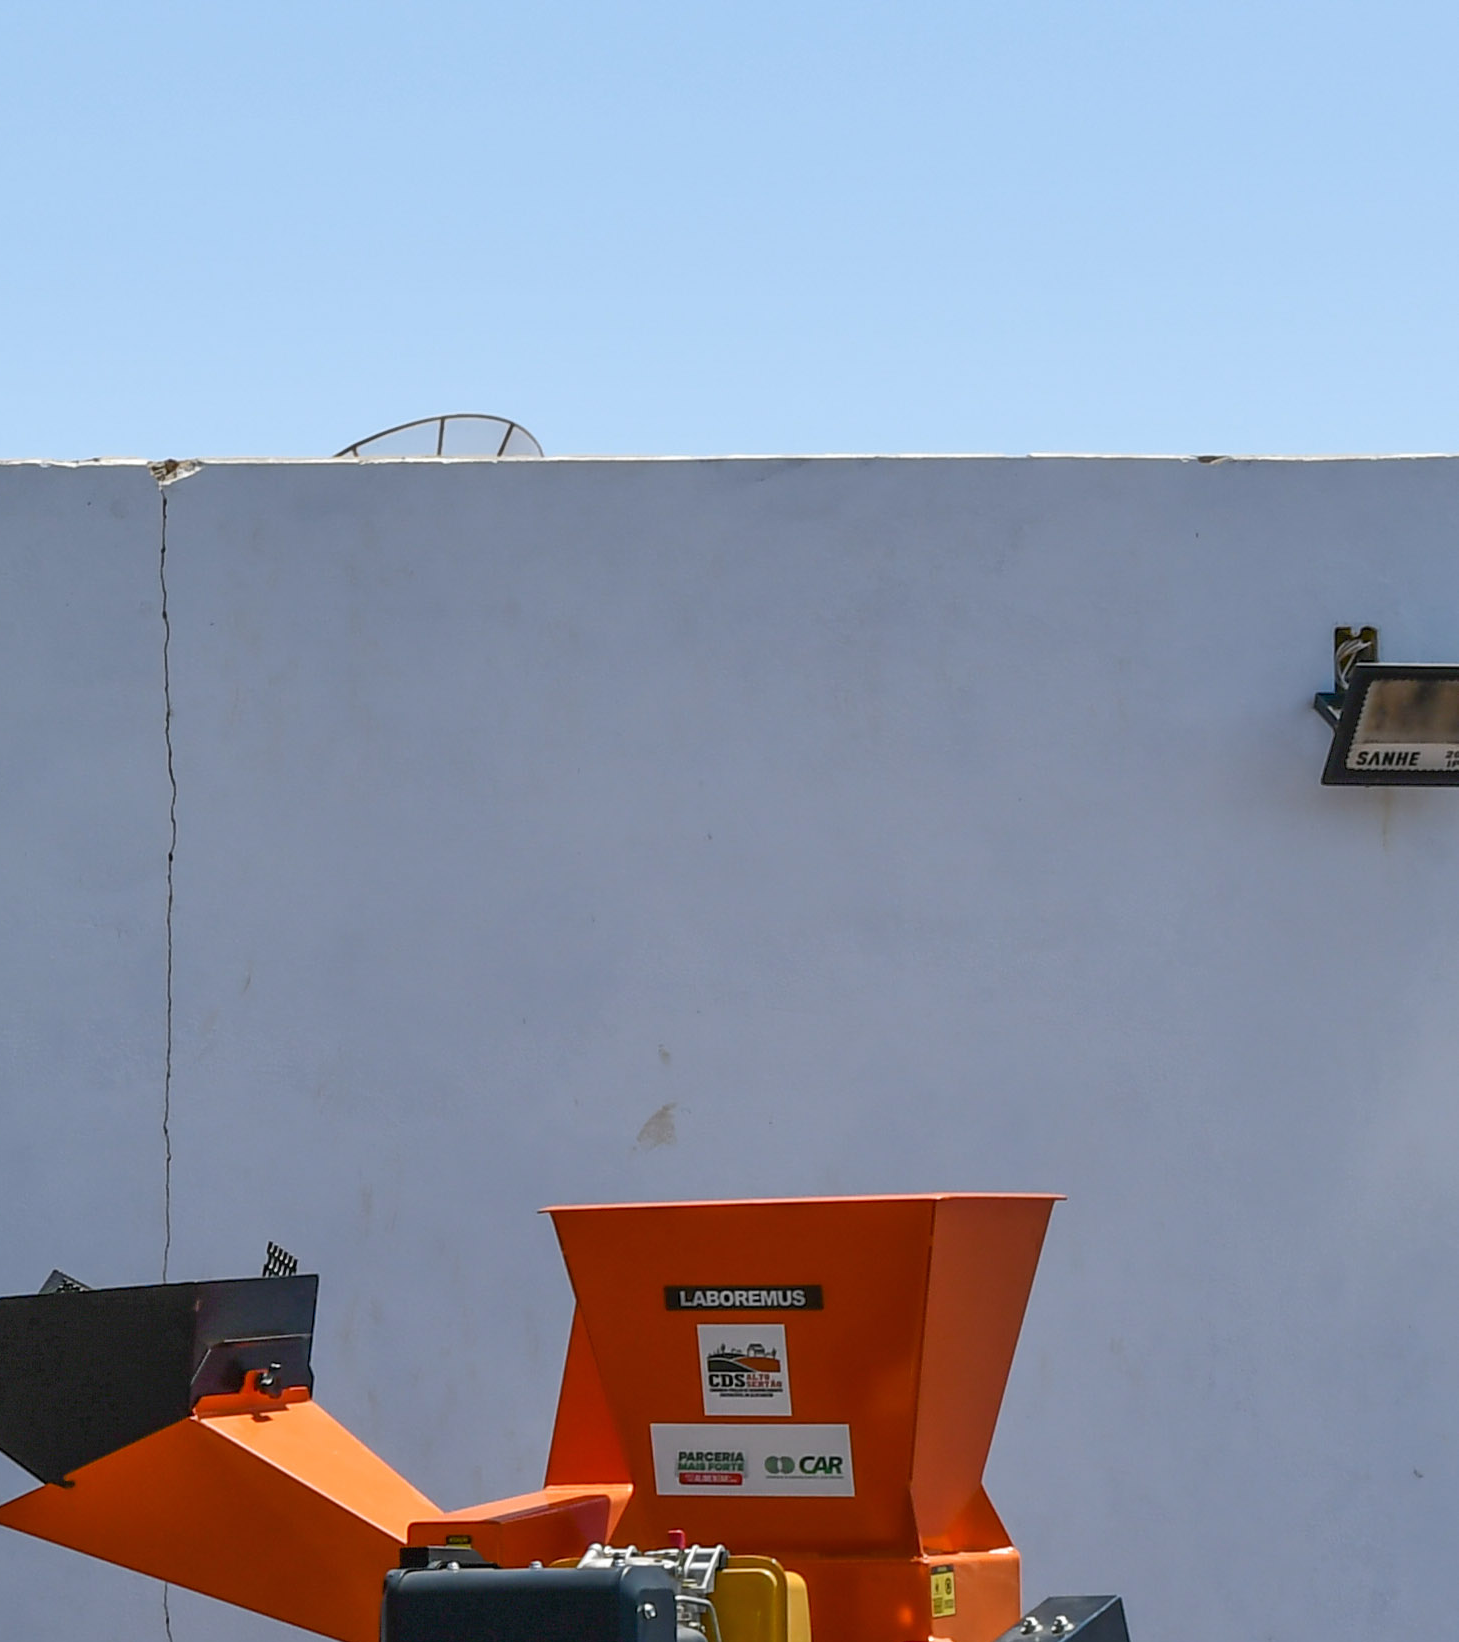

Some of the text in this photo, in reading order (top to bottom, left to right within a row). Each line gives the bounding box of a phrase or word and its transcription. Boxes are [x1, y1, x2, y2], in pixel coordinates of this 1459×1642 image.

[1356, 751, 1420, 766] SANHE
[679, 1289, 806, 1308] LABOREMUS
[709, 1374, 745, 1387] CDS
[678, 1452, 744, 1462] PARCERIA
[677, 1463, 744, 1471] MAIS FORTE
[799, 1456, 843, 1474] CAR
